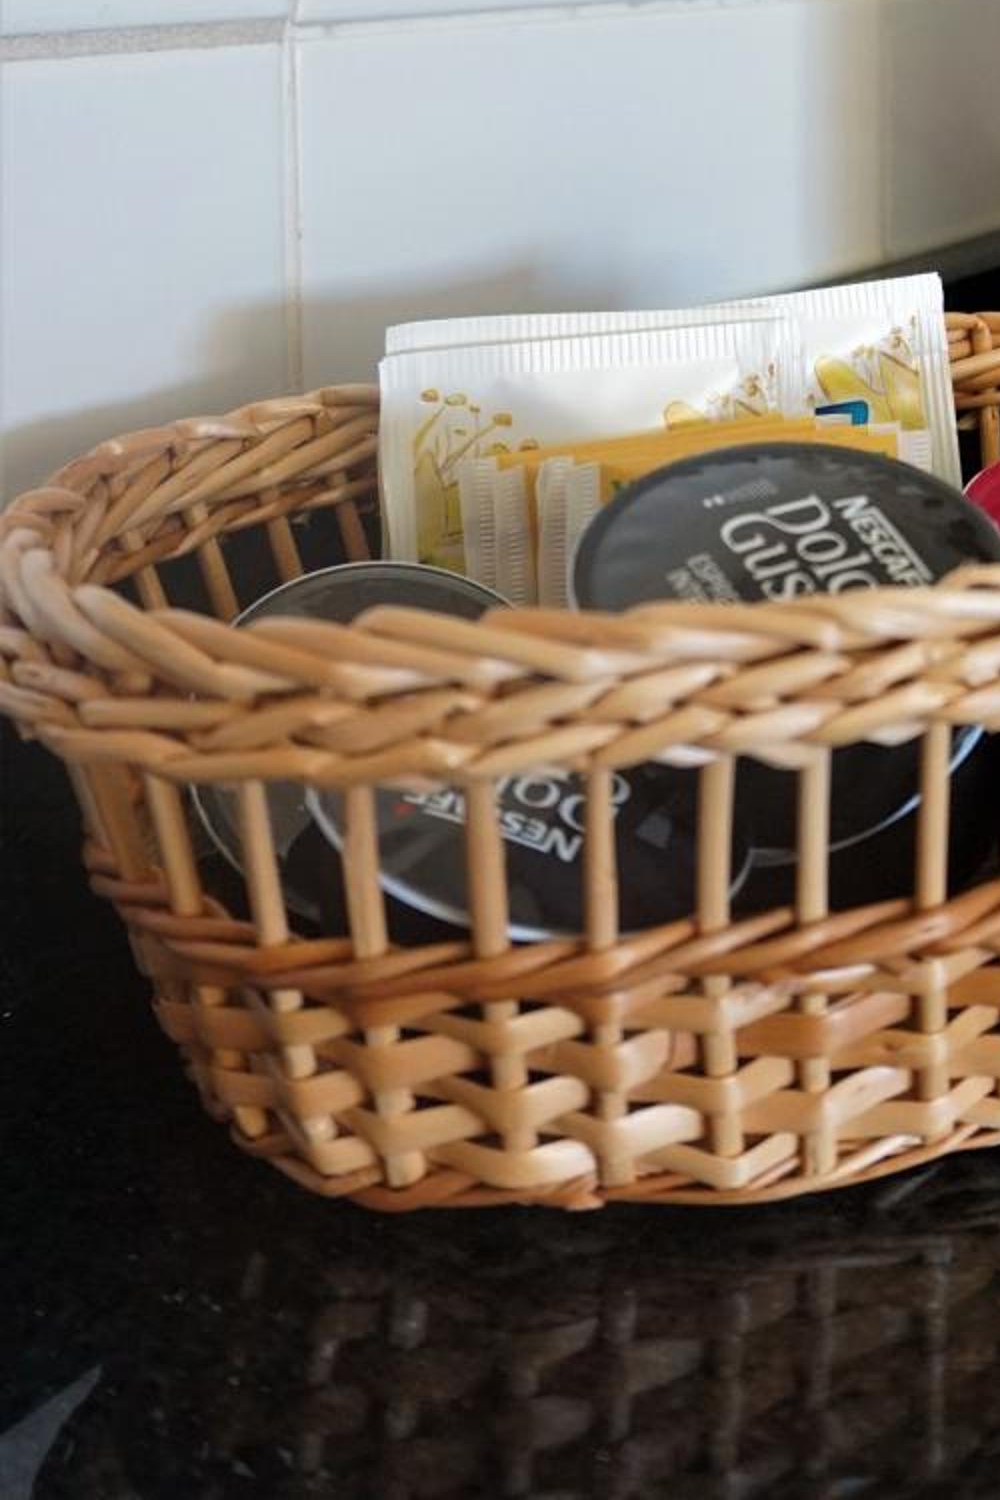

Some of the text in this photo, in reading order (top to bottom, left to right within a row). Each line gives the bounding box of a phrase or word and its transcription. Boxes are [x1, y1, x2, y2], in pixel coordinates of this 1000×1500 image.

[720, 512, 818, 601] Gus
[764, 495, 880, 592] Dolc
[832, 495, 934, 591] NESCAF
